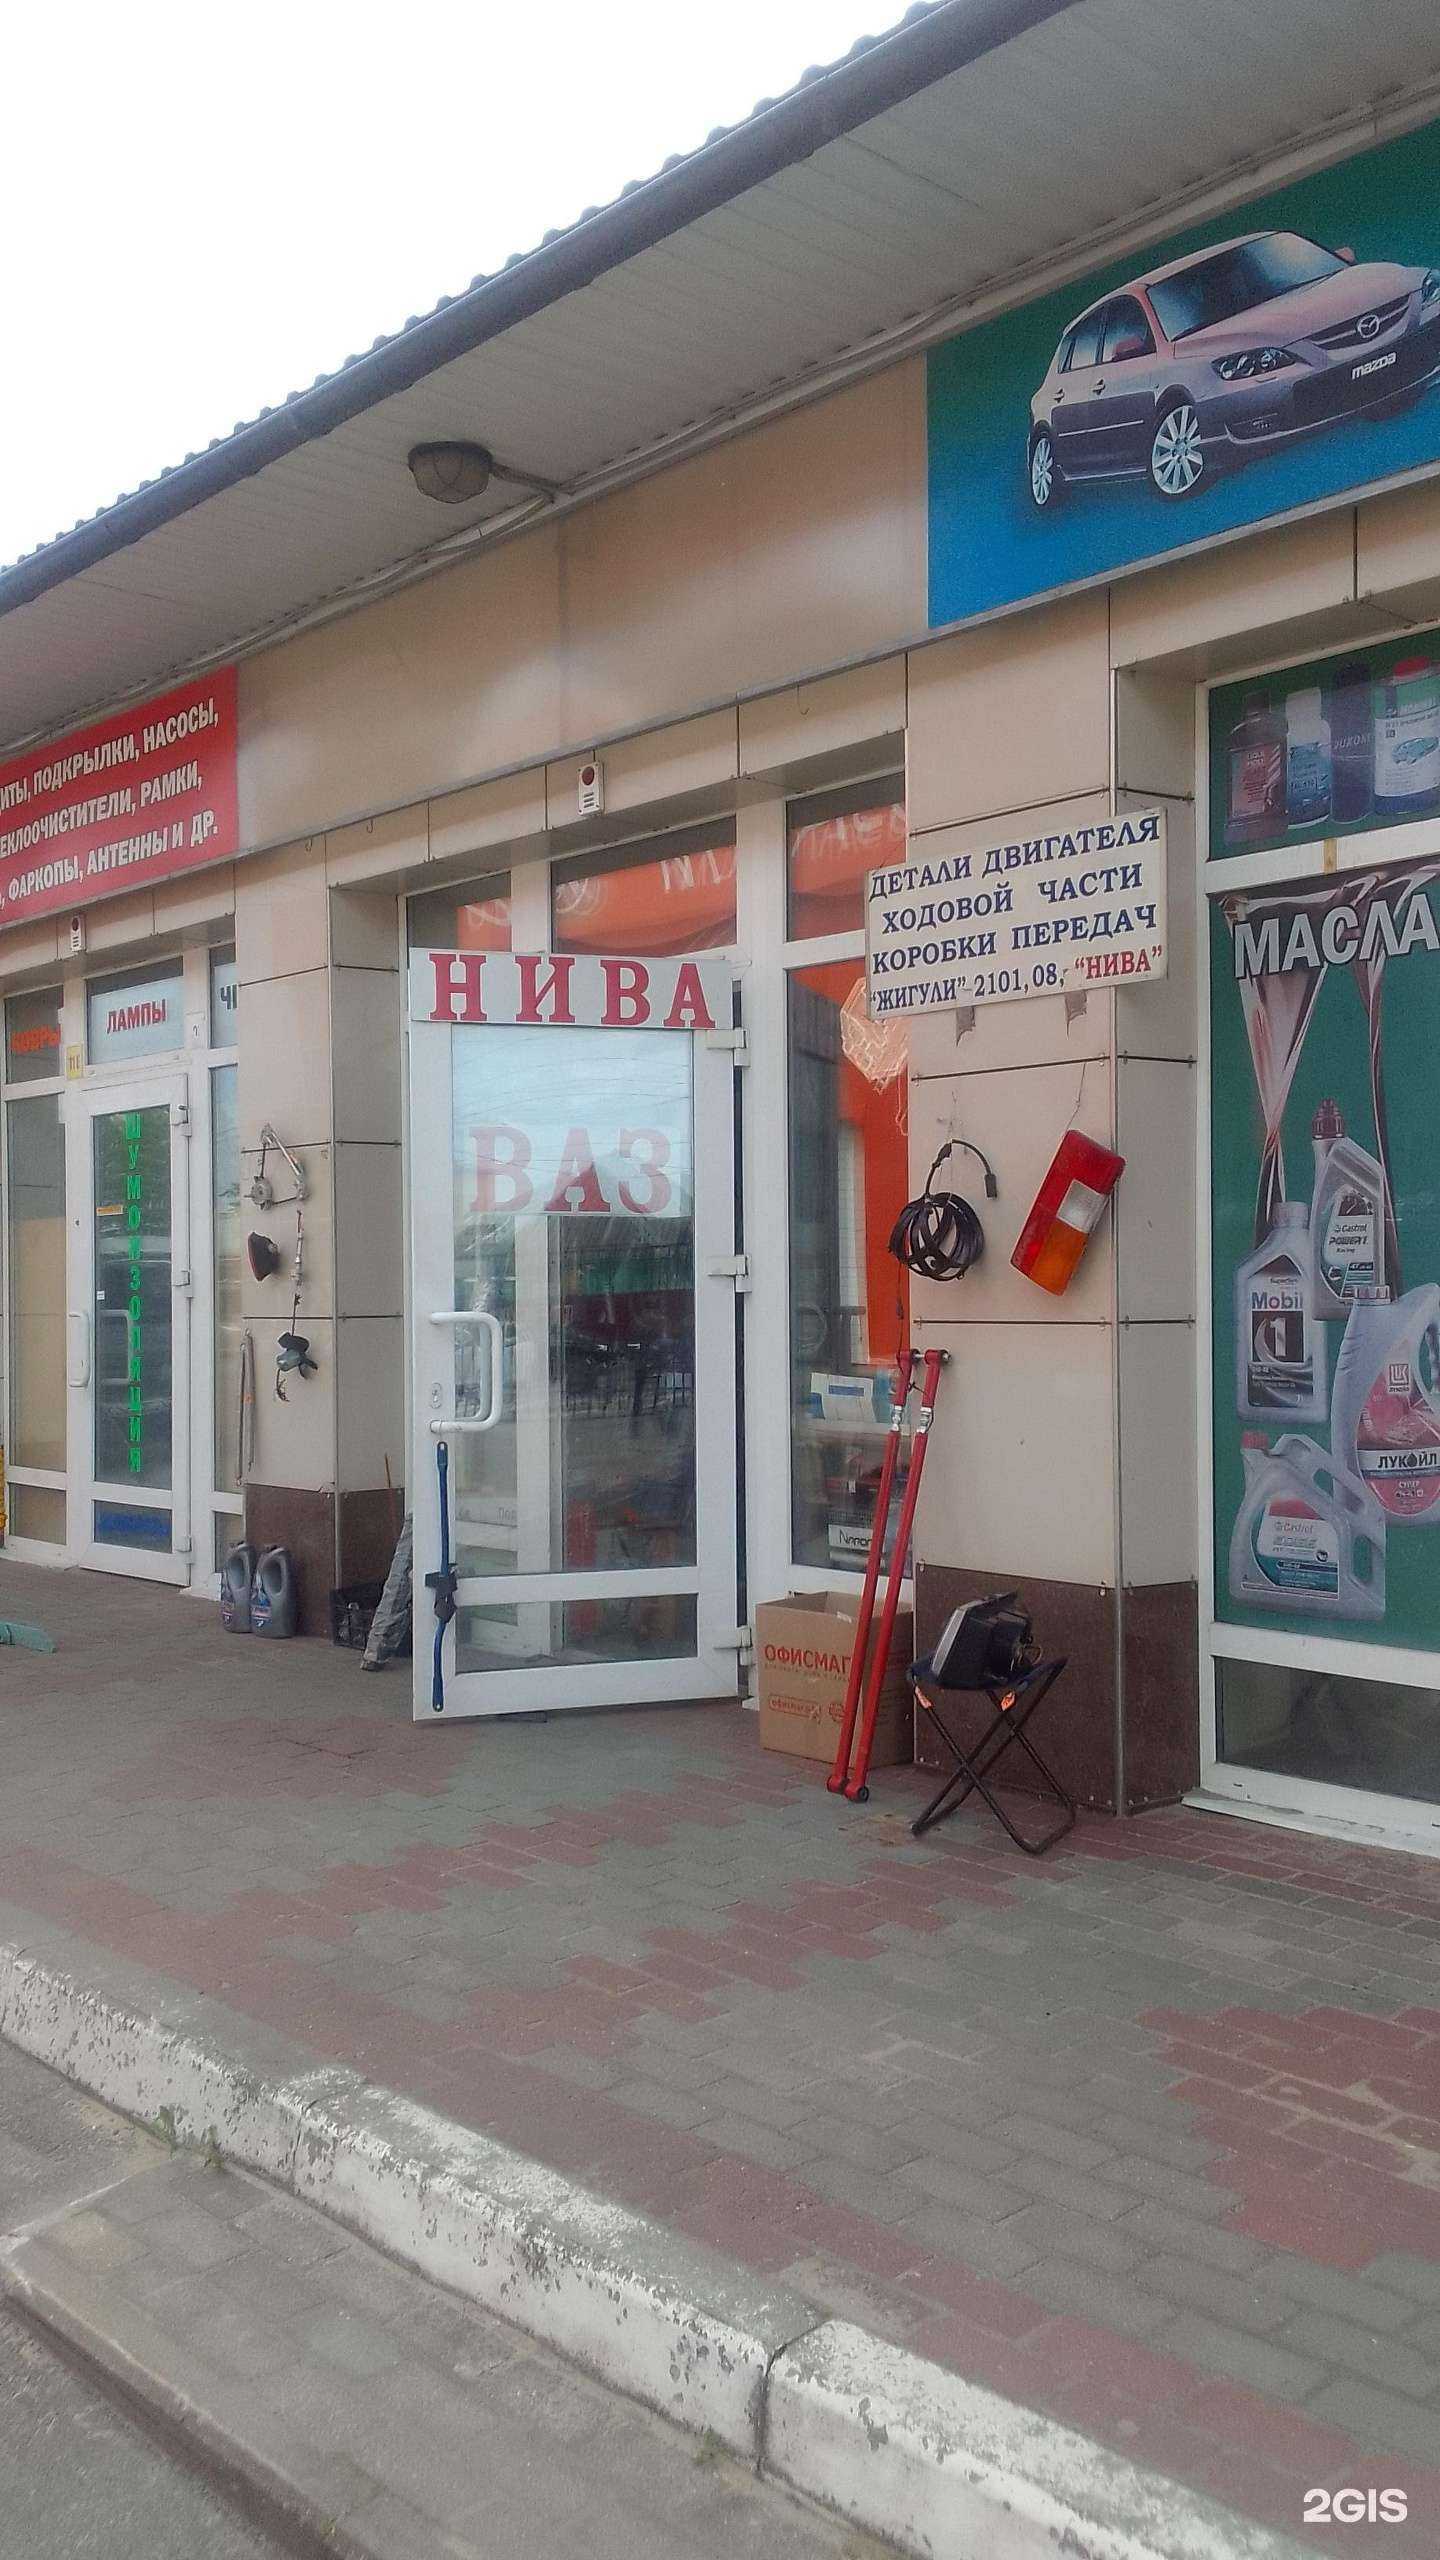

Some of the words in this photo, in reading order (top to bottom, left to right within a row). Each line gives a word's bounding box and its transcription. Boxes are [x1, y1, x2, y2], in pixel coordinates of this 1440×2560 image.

[0, 778, 31, 813] ИТЫ,
[33, 734, 140, 796] ПОДКРЫЛКИ,
[143, 698, 219, 753] НАСОСЫ,
[140, 760, 202, 807] РАМКИ,
[8, 856, 84, 901] ФАРКОПЫ,
[86, 827, 168, 875] АНТЕННЫ
[172, 822, 183, 850] И
[190, 810, 218, 847] ДР.
[869, 855, 972, 902] ДЕТАЛИ
[981, 815, 1160, 876] ДВИГАТЕЛЯ
[882, 882, 1013, 934] ХОДОВОЙ
[1037, 863, 1143, 904] ЧАСТИ
[872, 932, 996, 974] КОРОБКИ
[1011, 904, 1157, 950] ПЕРЕДАЧ
[1234, 893, 1440, 979] МАСЛА
[429, 953, 716, 1029] НИВА
[974, 967, 1029, 997] 2101,
[1032, 962, 1065, 987] 08,
[106, 999, 166, 1034] ЛАМПЫ
[469, 1127, 673, 1214] ВАЗ
[1252, 1291, 1303, 1310] Mobil
[764, 1644, 851, 1675] ОФИСМАГ
